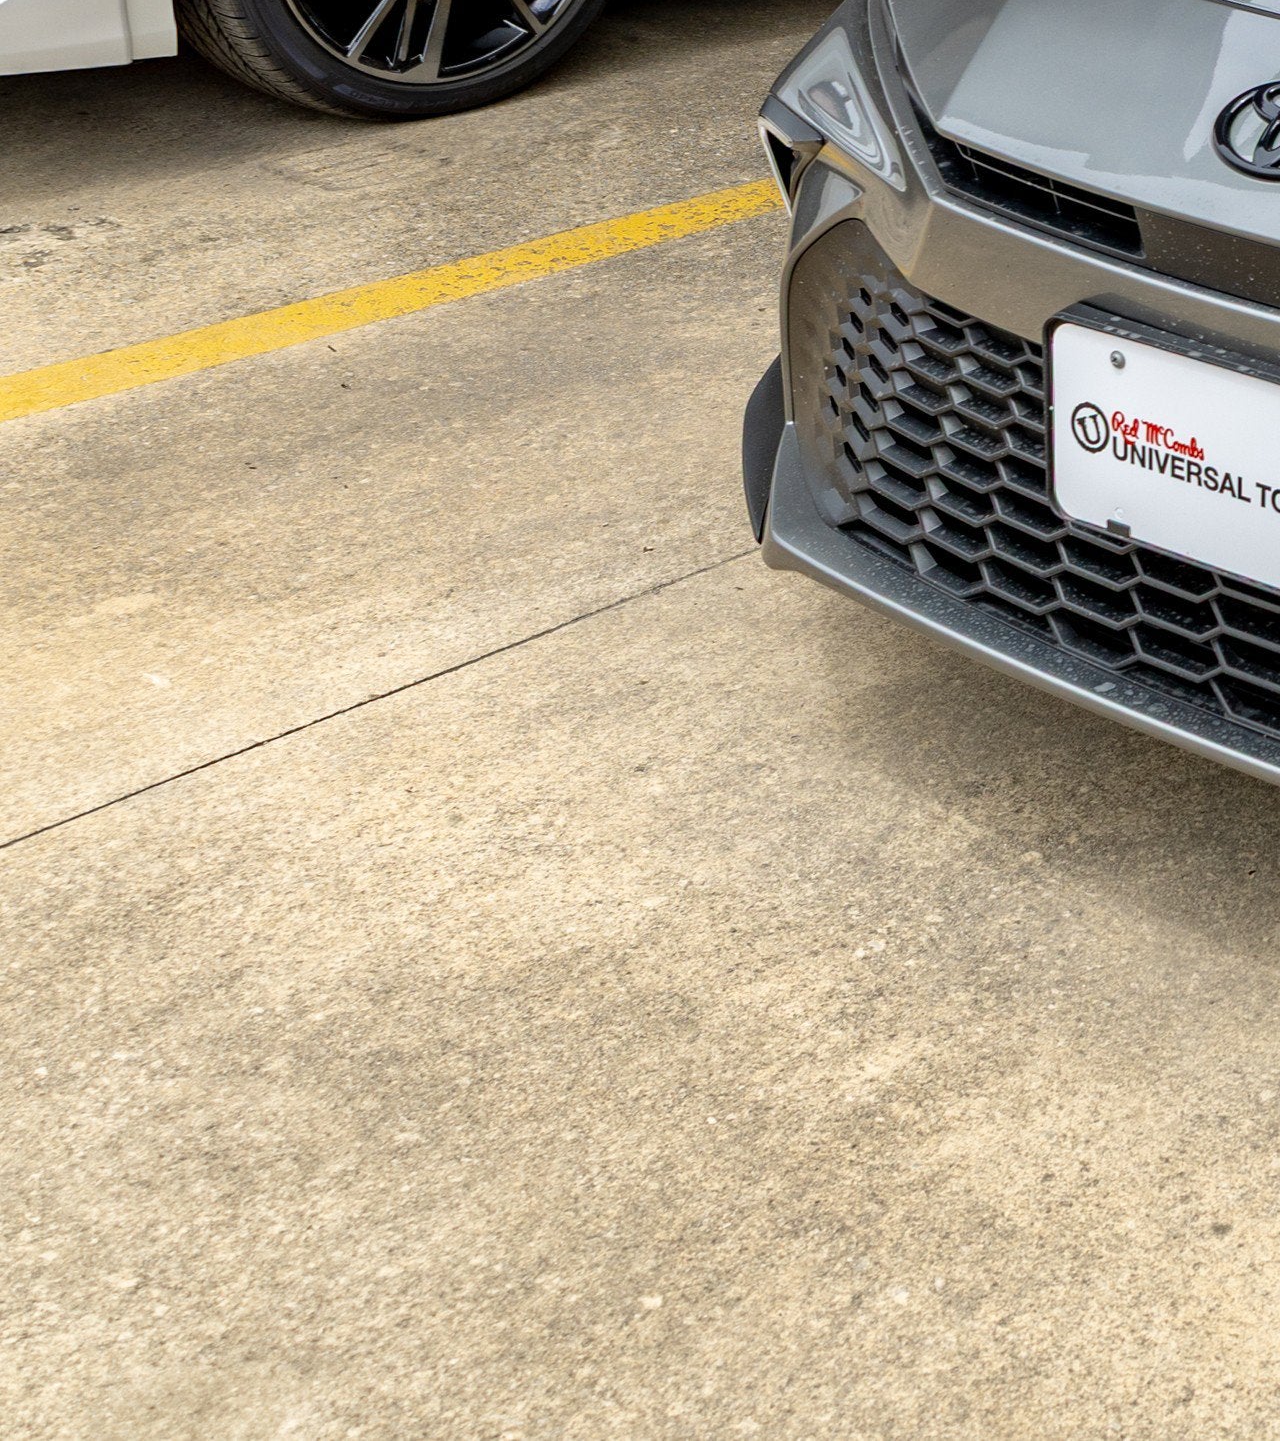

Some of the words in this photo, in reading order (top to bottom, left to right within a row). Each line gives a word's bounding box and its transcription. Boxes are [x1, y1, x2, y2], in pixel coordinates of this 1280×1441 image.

[1111, 411, 1139, 445] Red
[1141, 419, 1205, 461] McCombs
[1112, 436, 1252, 503] UNIVERSAL
